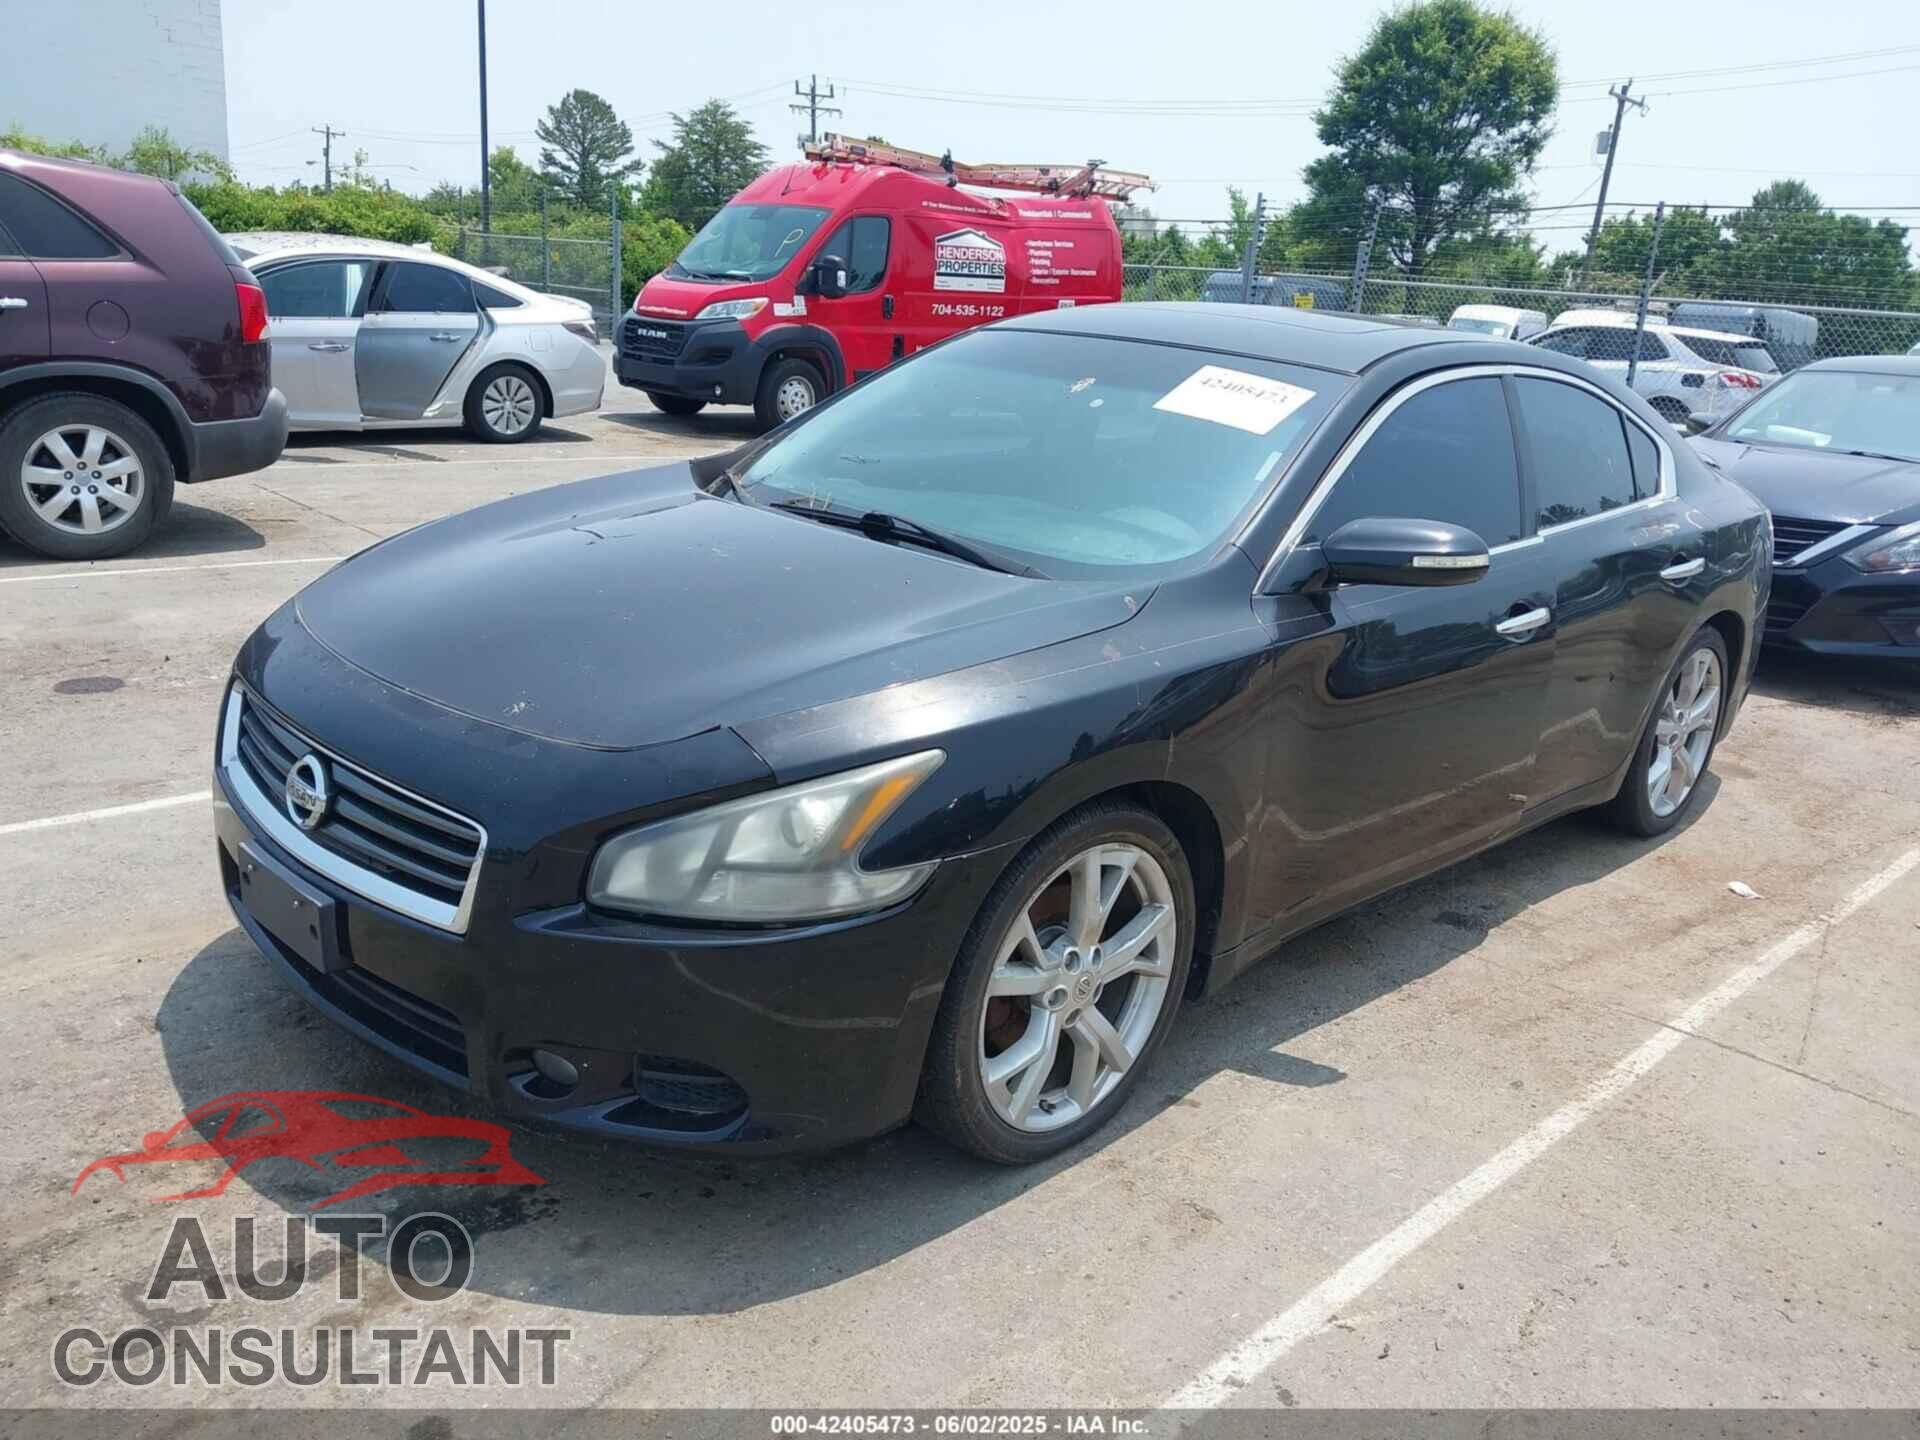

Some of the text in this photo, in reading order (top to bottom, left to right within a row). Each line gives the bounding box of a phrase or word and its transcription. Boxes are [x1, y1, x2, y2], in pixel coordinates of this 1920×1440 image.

[937, 246, 1004, 261] HENDERSON
[938, 260, 1005, 274] PROPERTIES
[931, 303, 1005, 317] 704-535-1122
[637, 327, 668, 339] RAM
